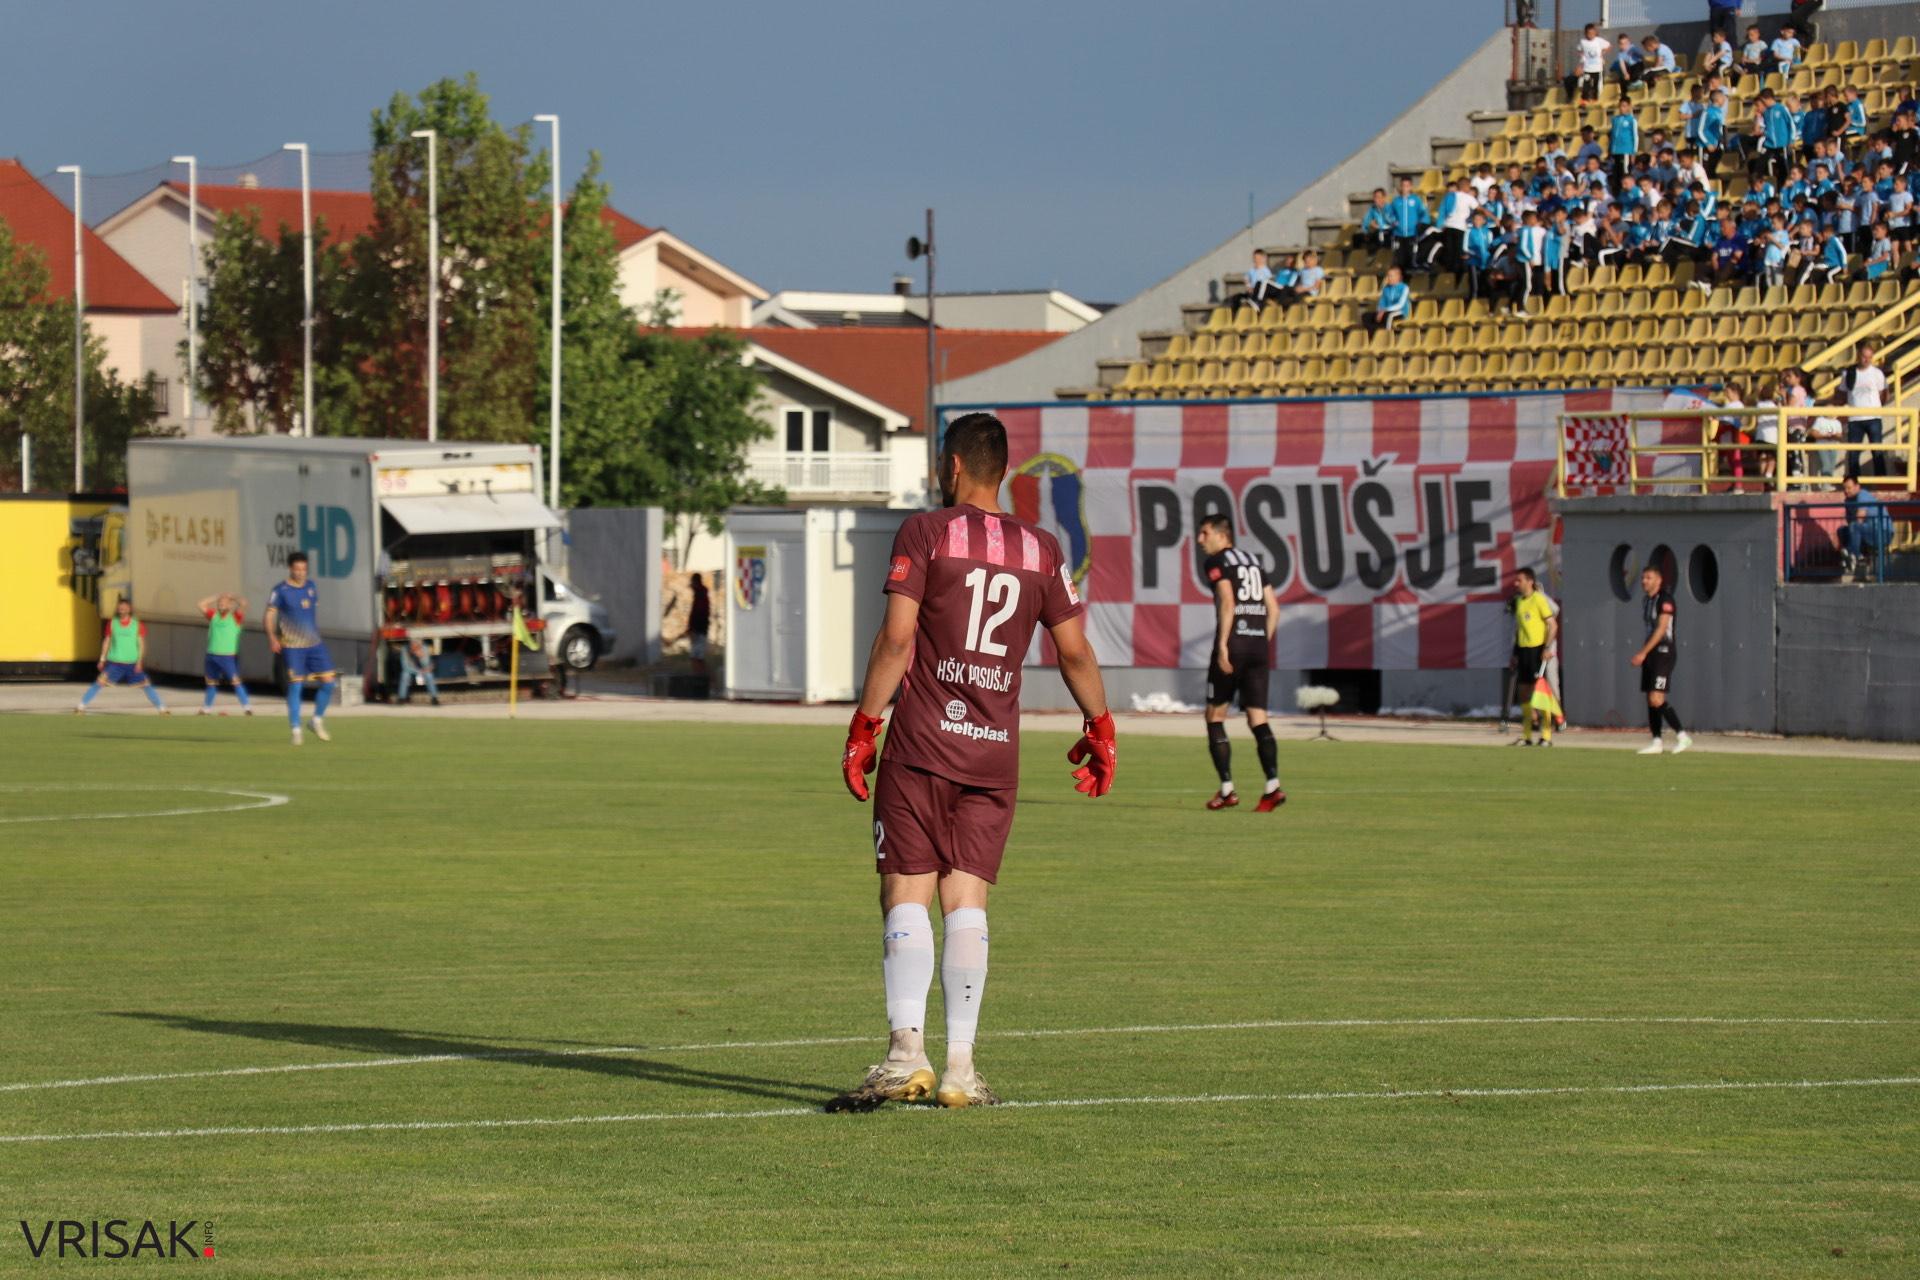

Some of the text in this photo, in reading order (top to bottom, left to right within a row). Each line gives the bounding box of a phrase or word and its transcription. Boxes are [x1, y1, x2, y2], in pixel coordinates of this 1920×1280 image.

[161, 514, 225, 546] FLASH
[275, 514, 295, 538] OB
[299, 505, 356, 579] HD
[1137, 459, 1496, 590] POSUŠJE
[1237, 565, 1264, 601] 30
[965, 567, 1021, 657] 12
[937, 657, 1014, 692] HŠK POSUŠJE
[940, 720, 1009, 742] weltplast
